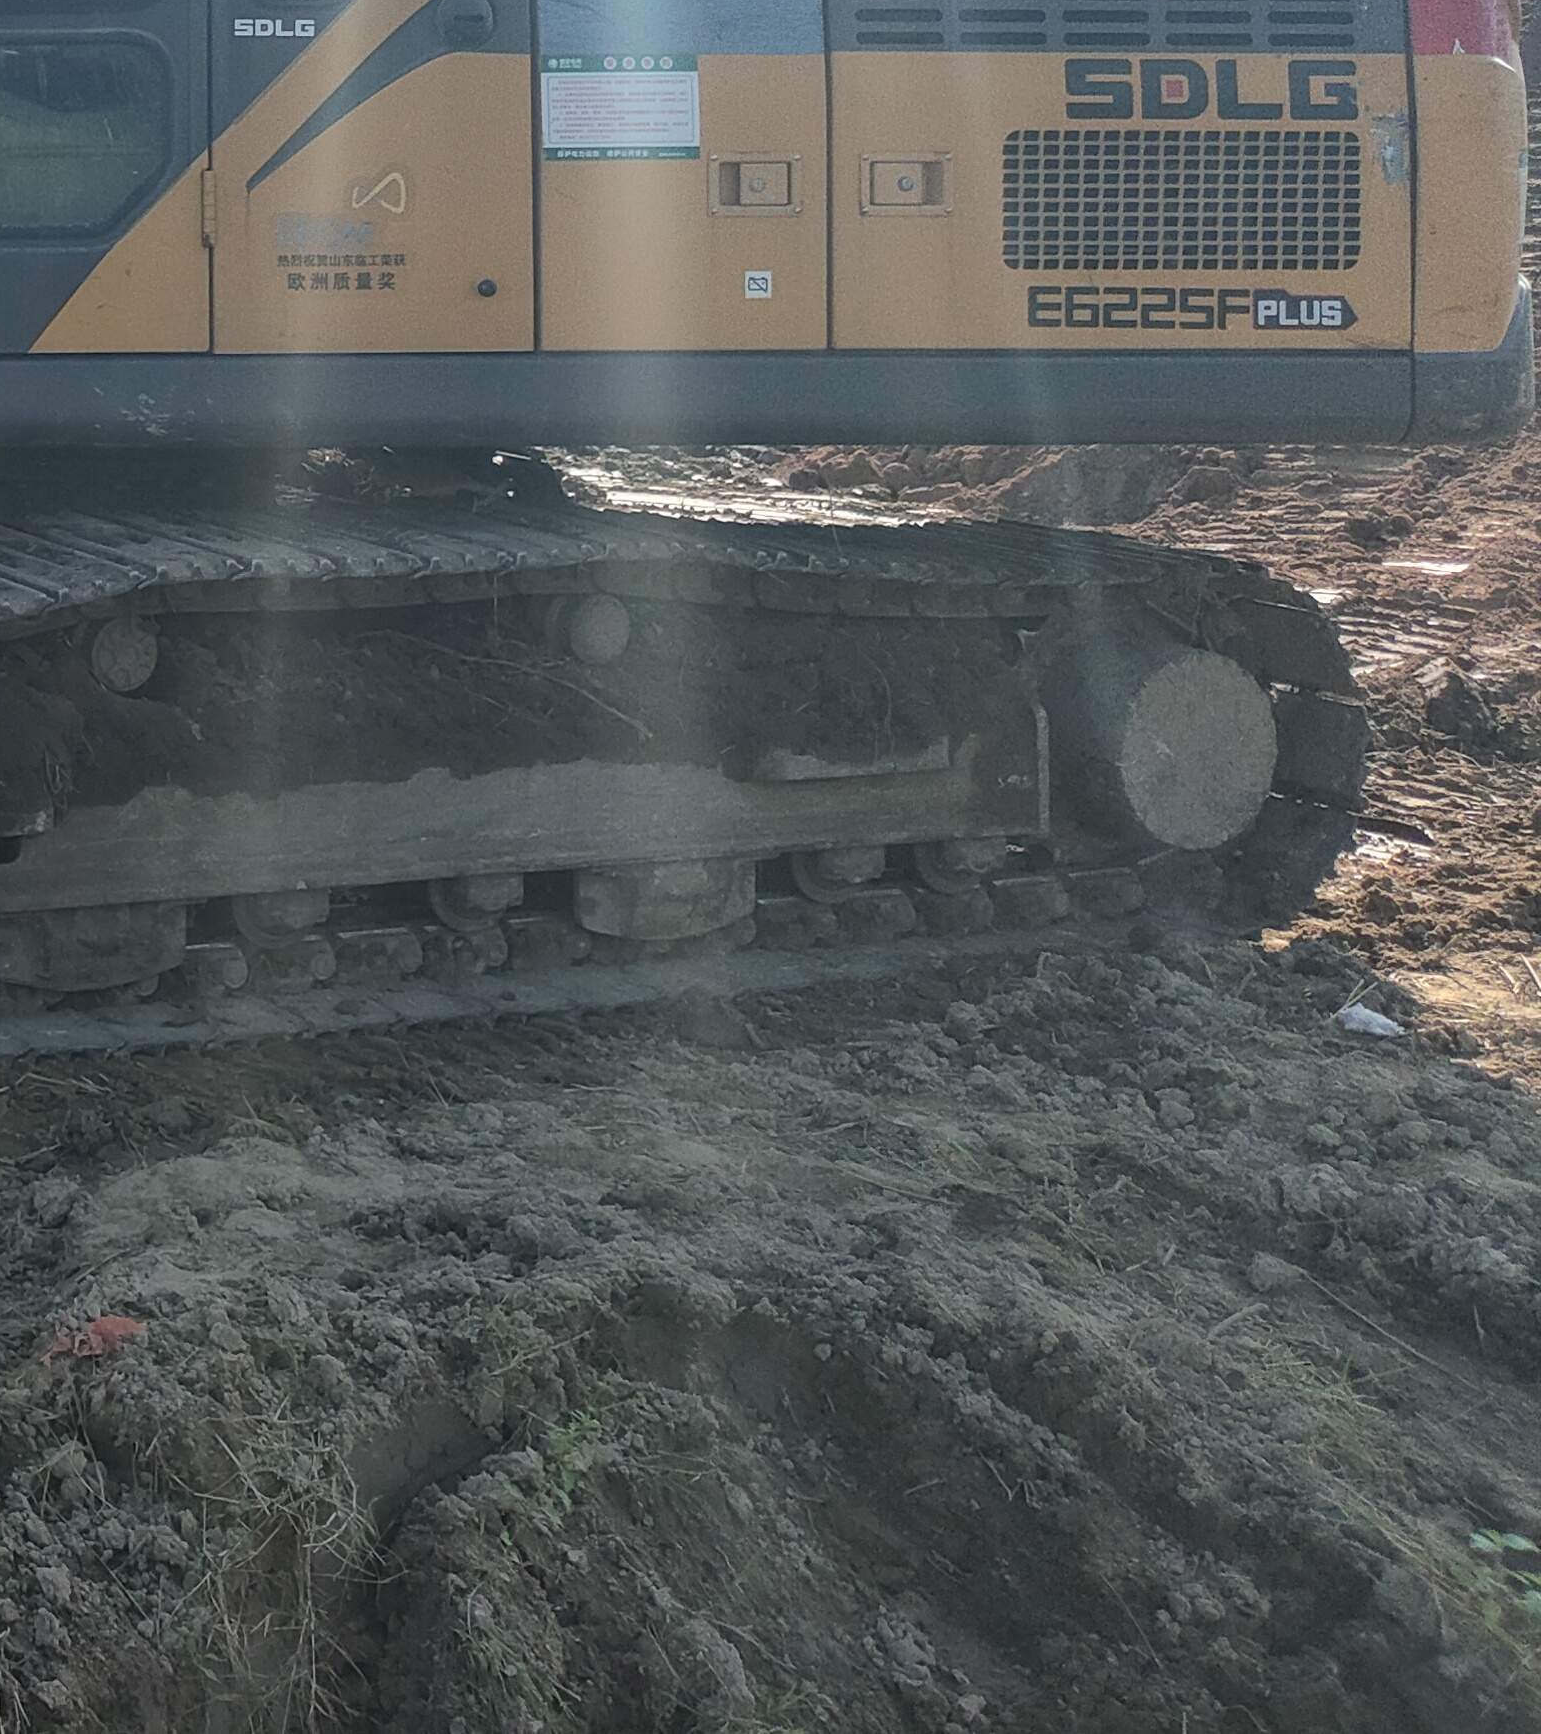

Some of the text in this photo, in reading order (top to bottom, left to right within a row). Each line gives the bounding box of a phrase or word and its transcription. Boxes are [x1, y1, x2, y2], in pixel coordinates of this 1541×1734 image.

[233, 18, 316, 37] SDLG
[1064, 58, 1359, 121] SDLG
[287, 272, 396, 291] 欧洲质量奖
[1028, 286, 1343, 330] E6225F PLUS
